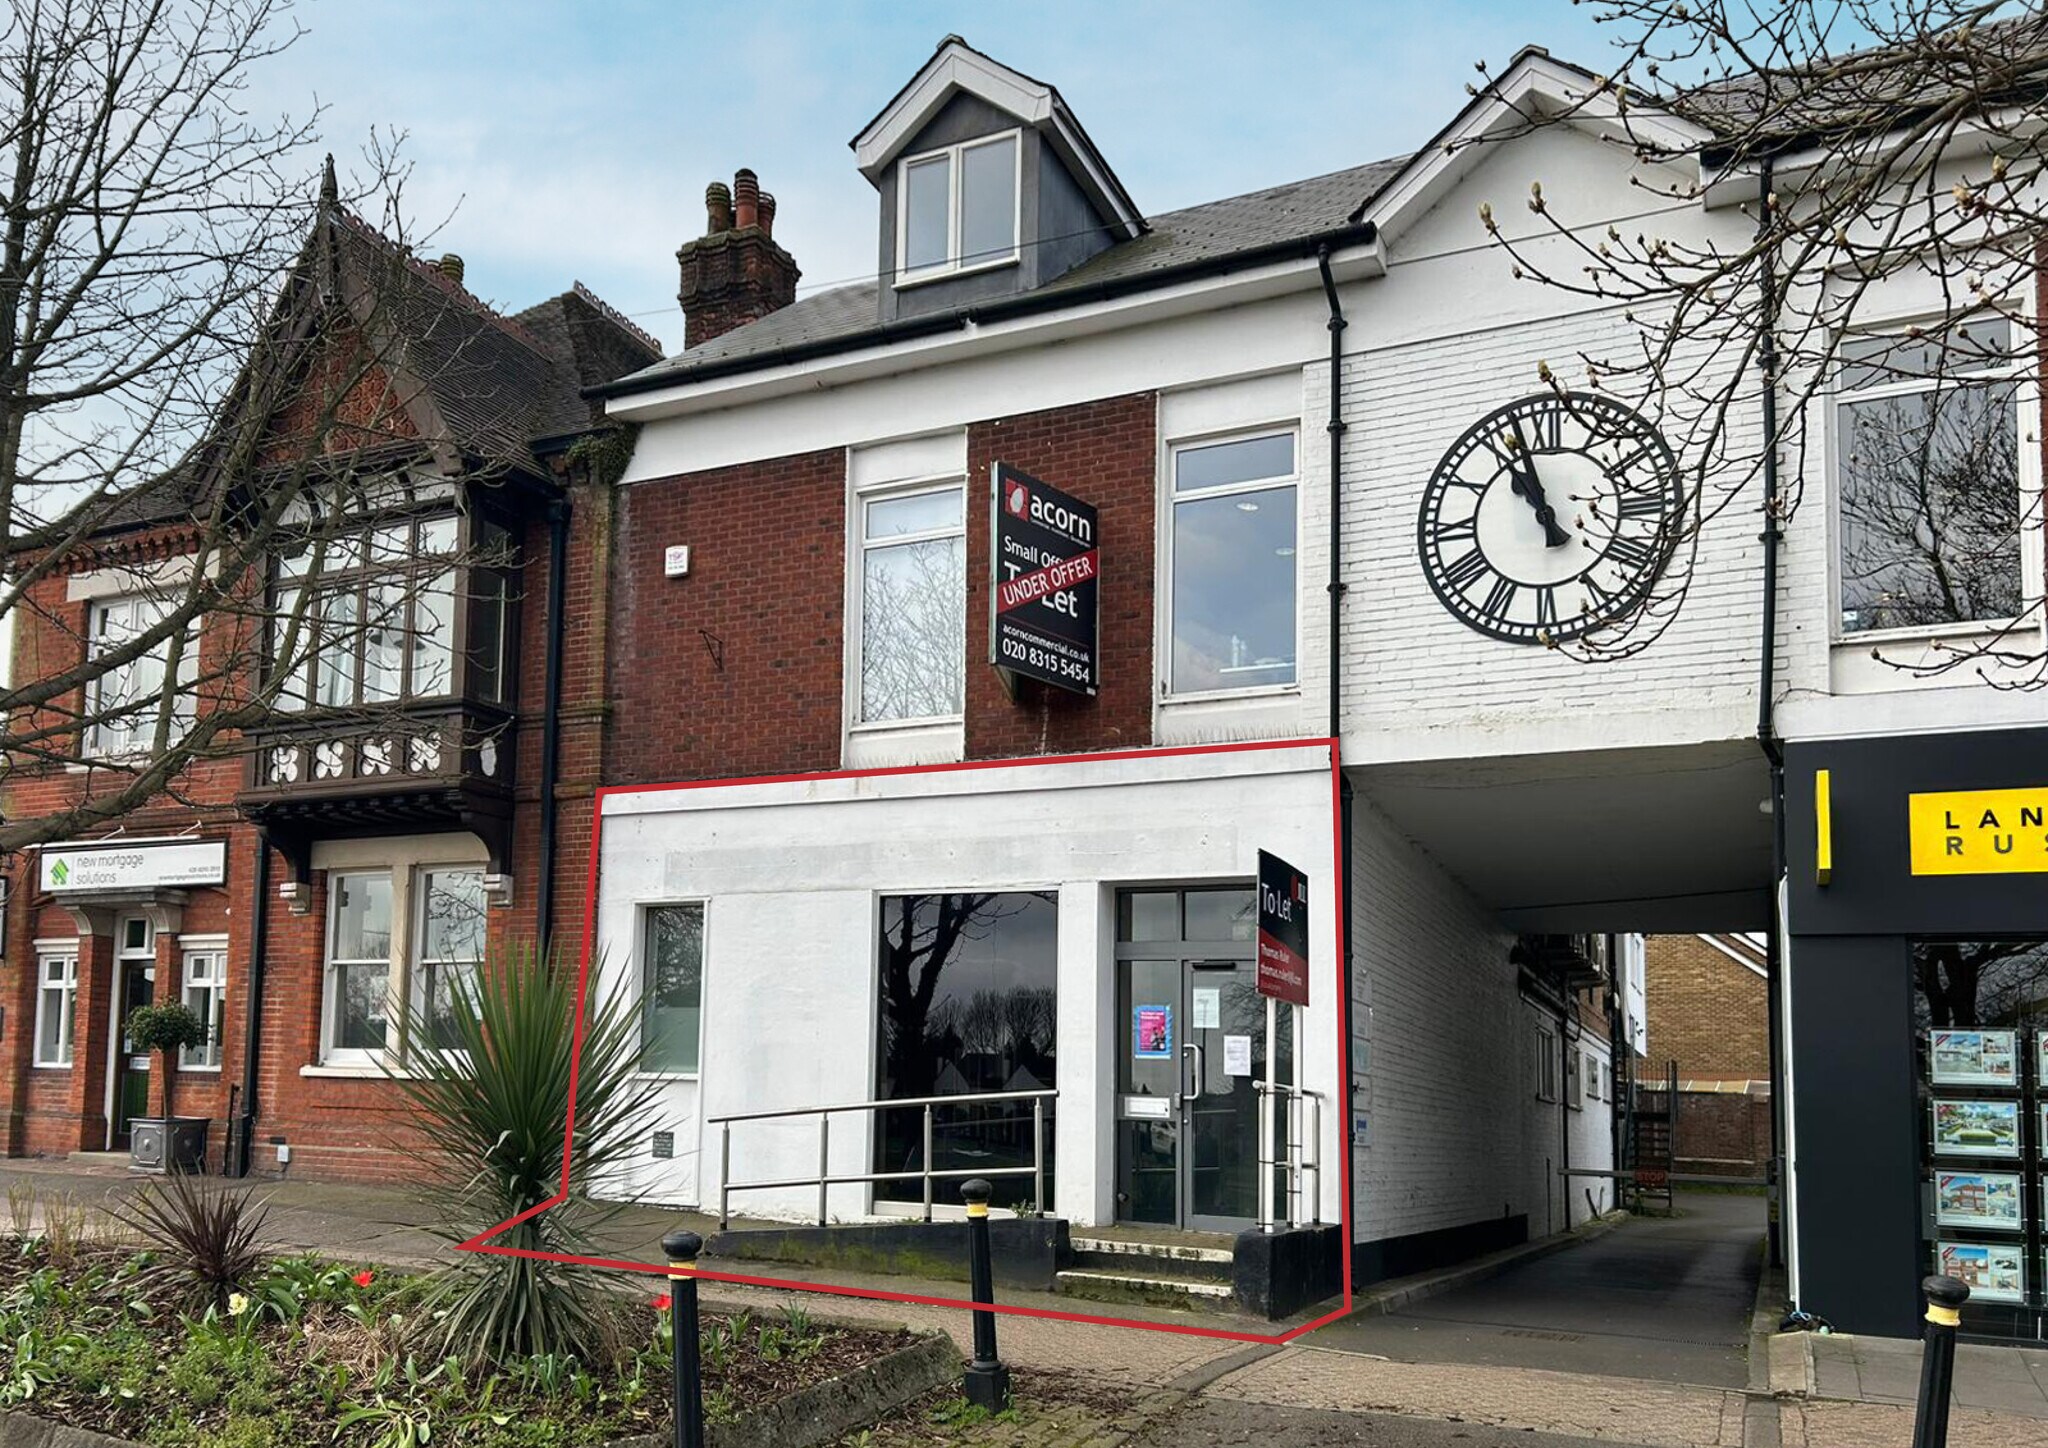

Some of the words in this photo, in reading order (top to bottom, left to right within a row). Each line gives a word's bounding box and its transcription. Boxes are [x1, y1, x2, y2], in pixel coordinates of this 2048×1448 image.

[1030, 494, 1091, 541] acorn
[1004, 535, 1038, 564] Small
[1003, 572, 1050, 605] UNDER
[1050, 556, 1094, 588] OFFER
[1003, 624, 1090, 663] acorncommercial.co.uk
[1003, 638, 1026, 661] 020
[1029, 647, 1058, 672] 8315
[1060, 658, 1090, 684] 5454
[76, 857, 97, 868] new
[98, 854, 144, 869] mortgage
[1946, 834, 2048, 857] RU
[76, 870, 117, 885] solutions
[1261, 882, 1276, 915] To
[1277, 889, 1292, 923] Let
[1636, 1172, 1664, 1181] STOP
